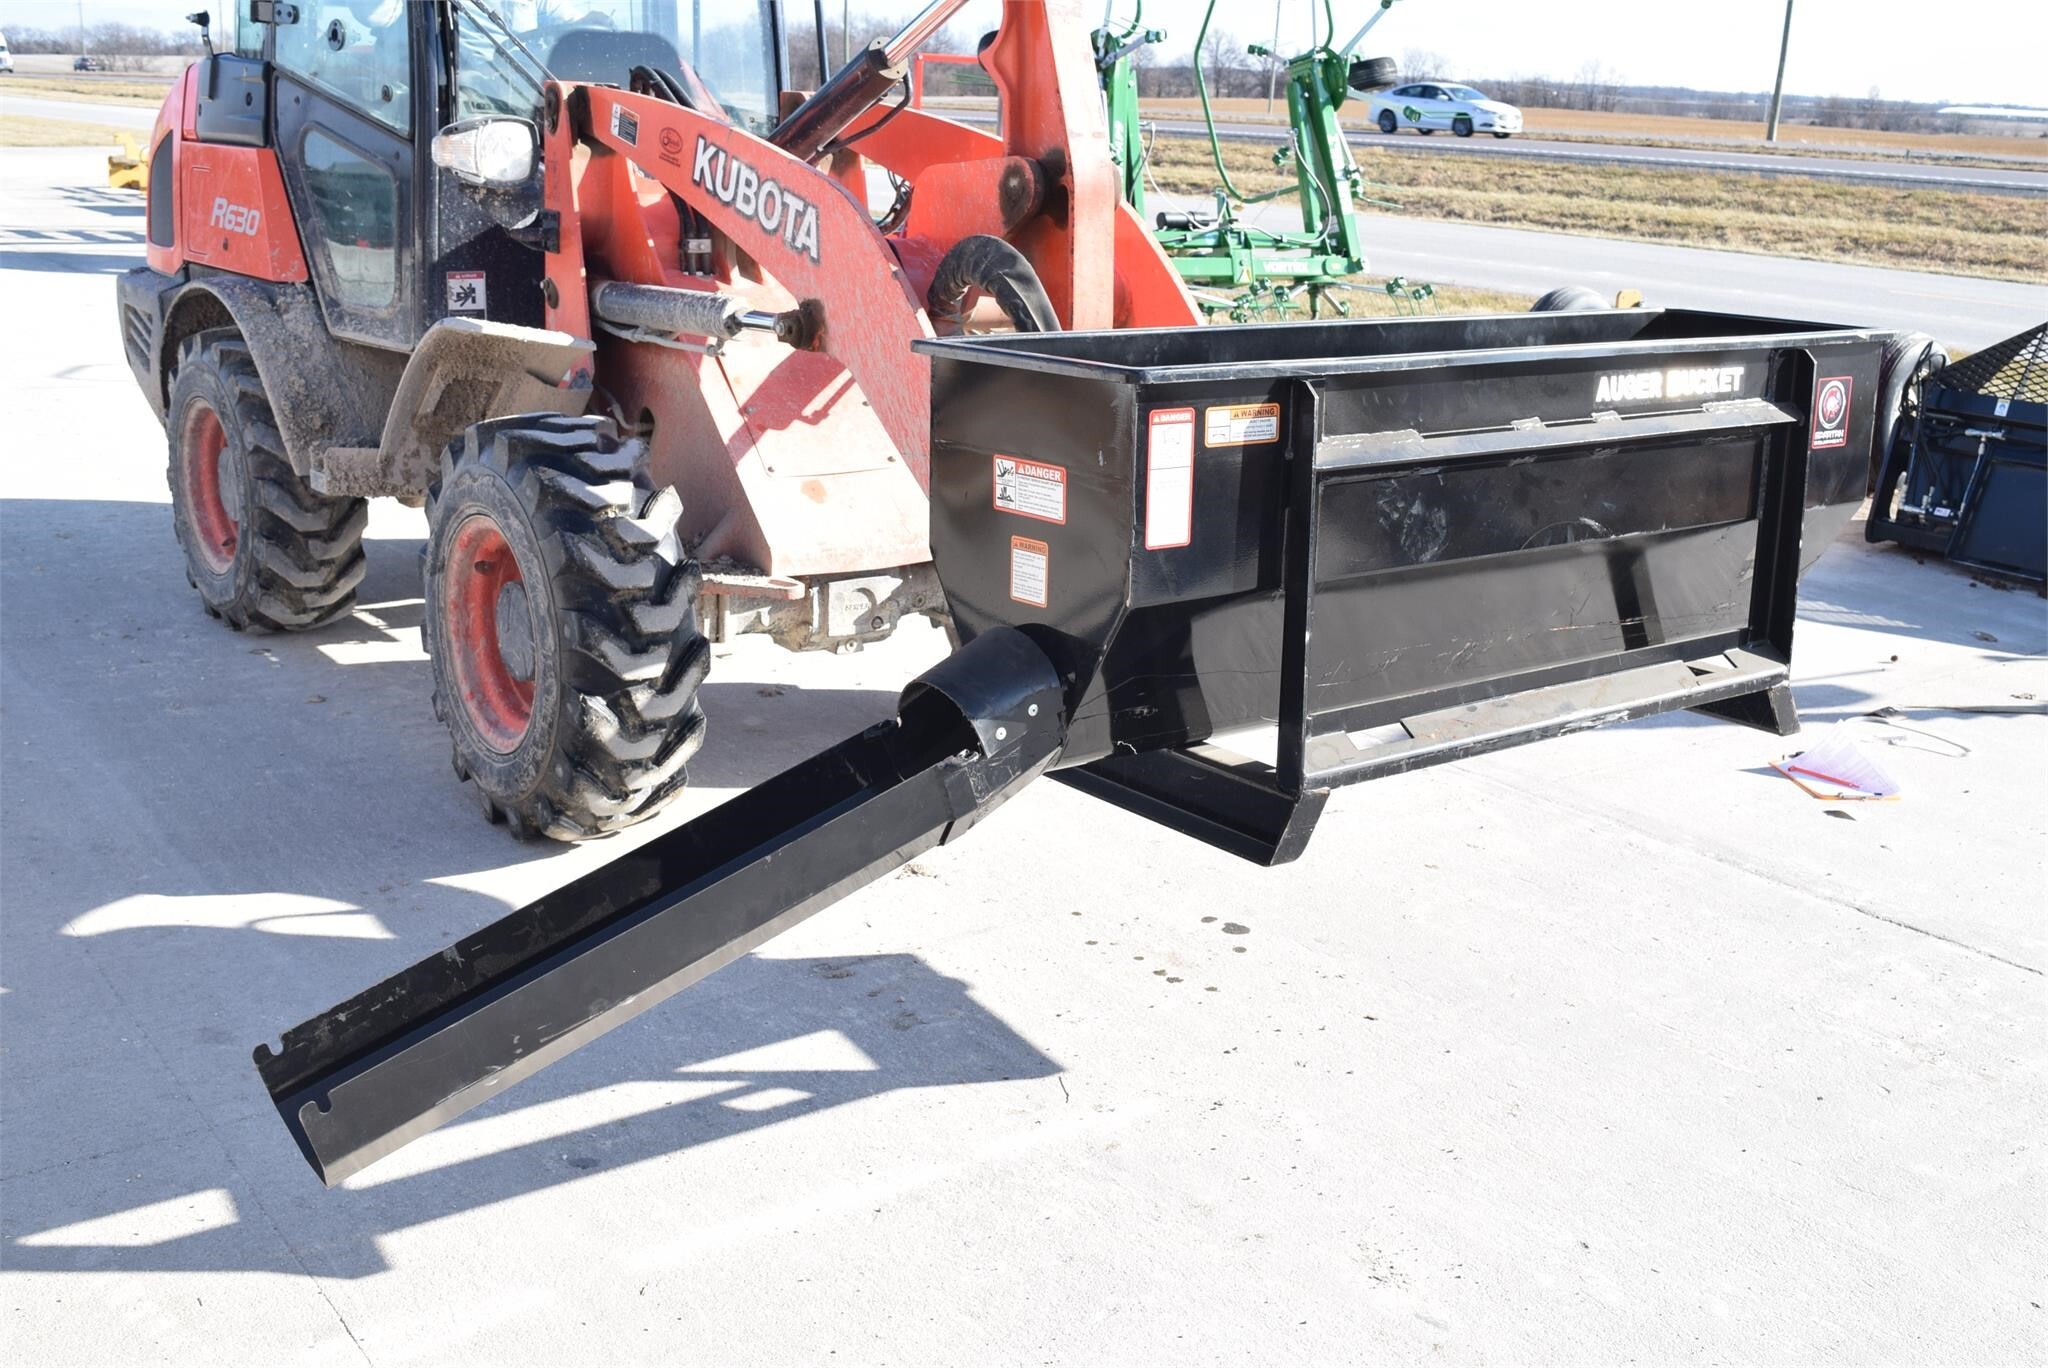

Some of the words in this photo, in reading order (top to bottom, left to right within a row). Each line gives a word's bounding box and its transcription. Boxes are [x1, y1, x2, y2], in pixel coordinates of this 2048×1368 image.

[692, 137, 820, 262] KUBOTA
[210, 196, 260, 236] R630
[1595, 371, 1664, 402] AUGER
[1160, 412, 1191, 422] DANGER
[1240, 407, 1275, 418] WARNING
[1025, 466, 1061, 482] DANGER
[1019, 541, 1046, 554] WARNING
